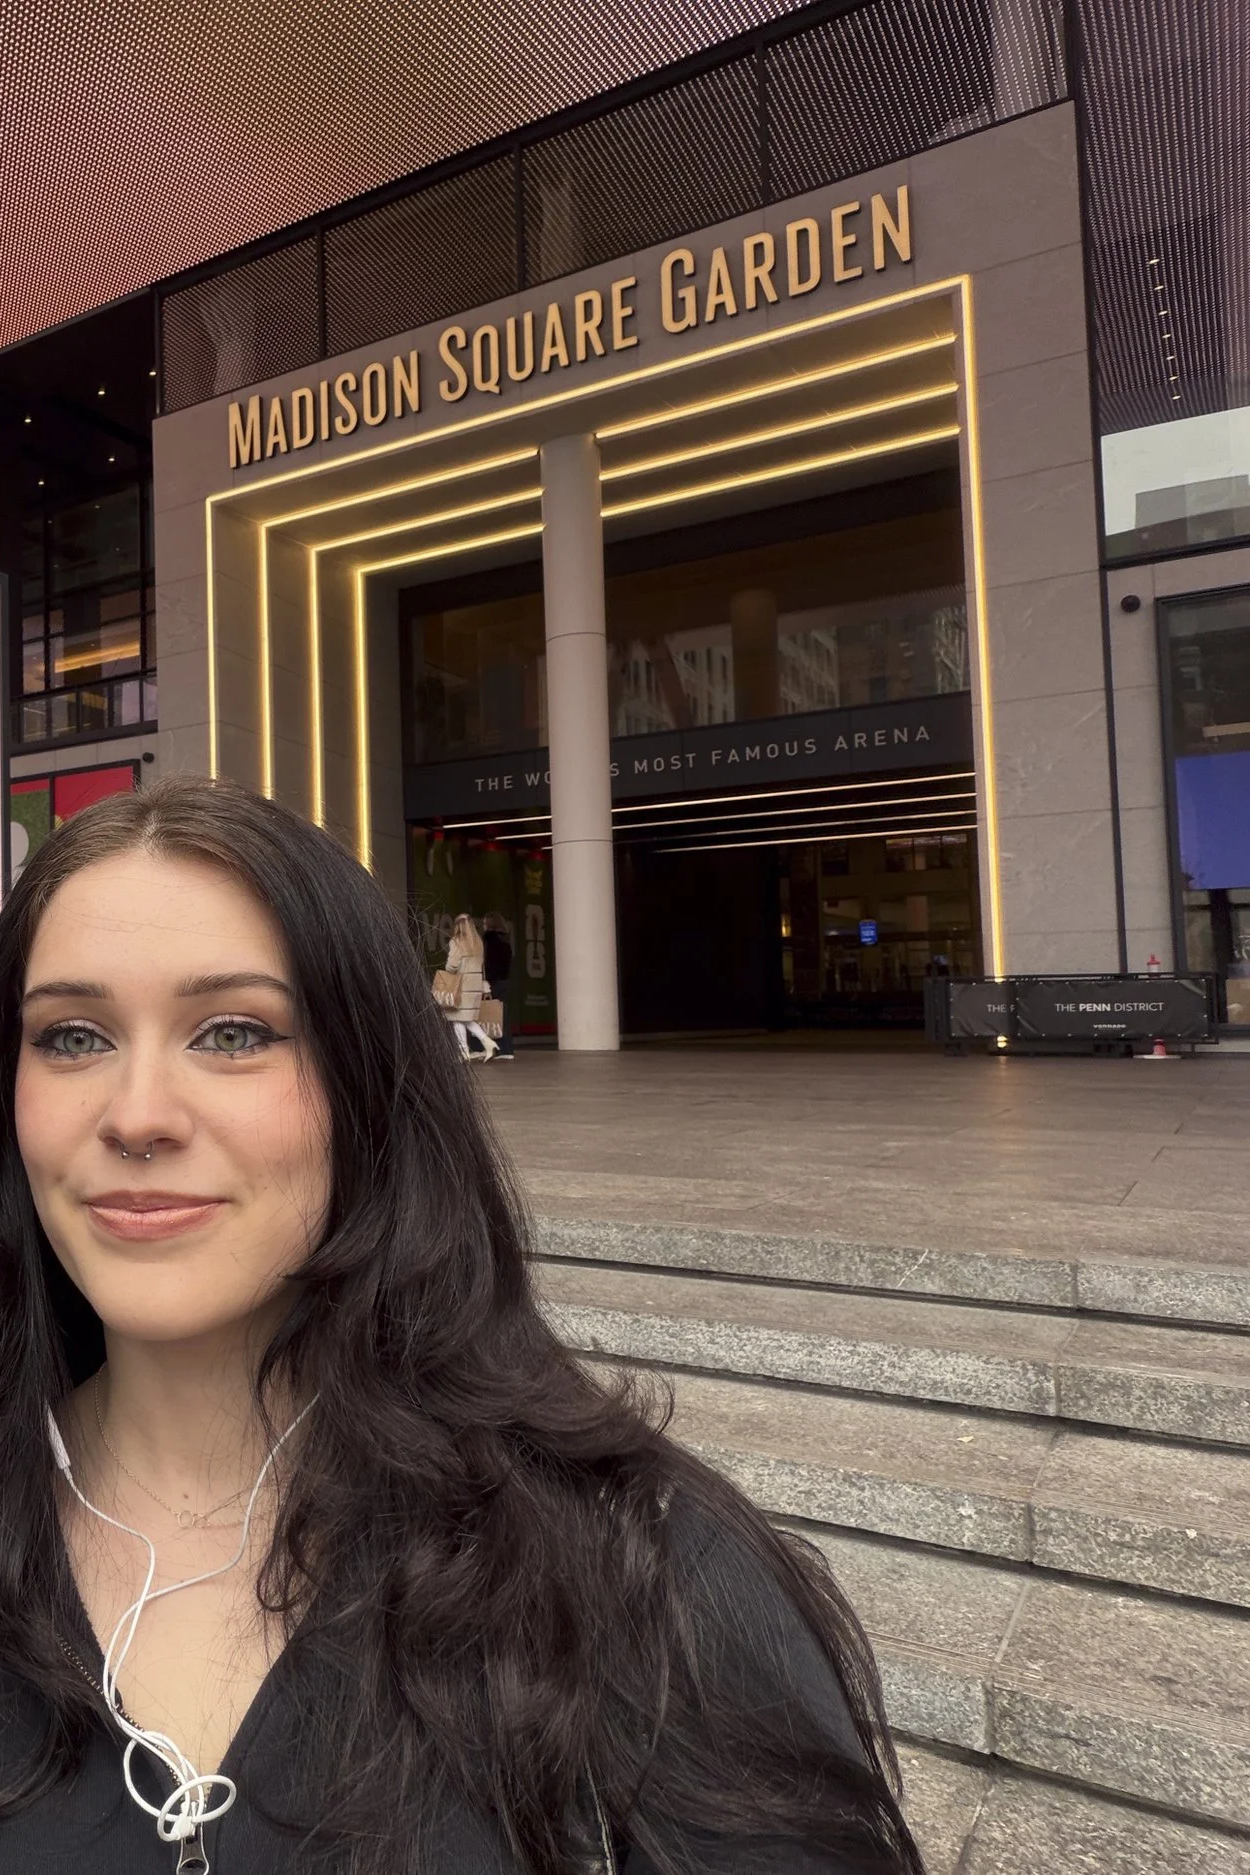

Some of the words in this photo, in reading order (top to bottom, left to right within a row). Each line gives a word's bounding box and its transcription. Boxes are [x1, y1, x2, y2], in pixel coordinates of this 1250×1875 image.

[228, 351, 420, 469] MADISON
[438, 276, 639, 402] SQUARE
[660, 184, 912, 334] GARDEN
[475, 775, 513, 792] THE
[634, 752, 697, 774] MOST
[711, 738, 818, 766] FAMOUS
[834, 725, 931, 751] ARENA
[987, 1004, 1007, 1013] THE
[1055, 1003, 1077, 1012] THE
[1079, 1002, 1111, 1012] PENN
[1114, 1002, 1165, 1012] DISTRICT
